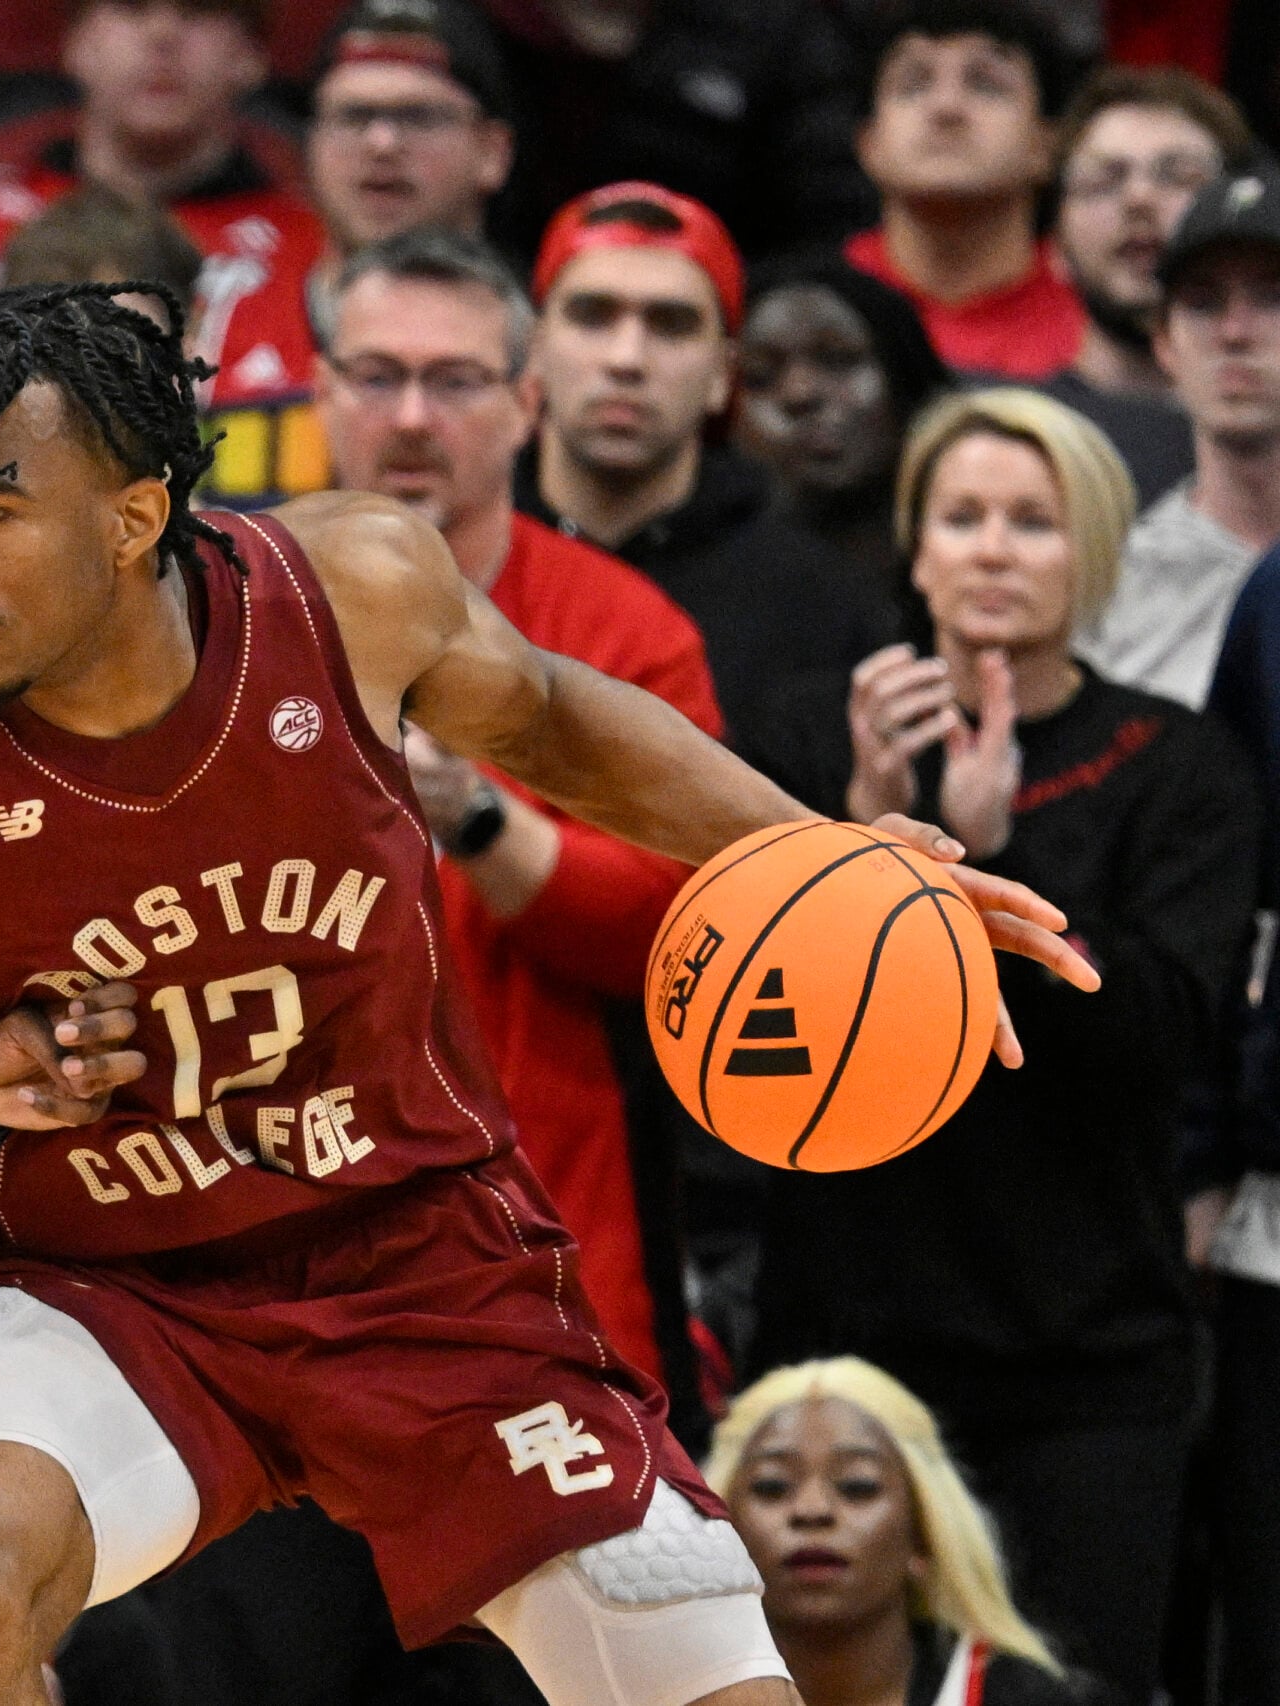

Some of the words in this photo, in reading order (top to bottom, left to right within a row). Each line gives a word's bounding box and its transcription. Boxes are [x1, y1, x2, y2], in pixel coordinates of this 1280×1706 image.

[278, 707, 317, 737] ACC
[664, 923, 725, 1040] PRO
[673, 913, 705, 958] OFFICIAL
[151, 964, 304, 1119] 13
[67, 1084, 376, 1204] COLLEGE
